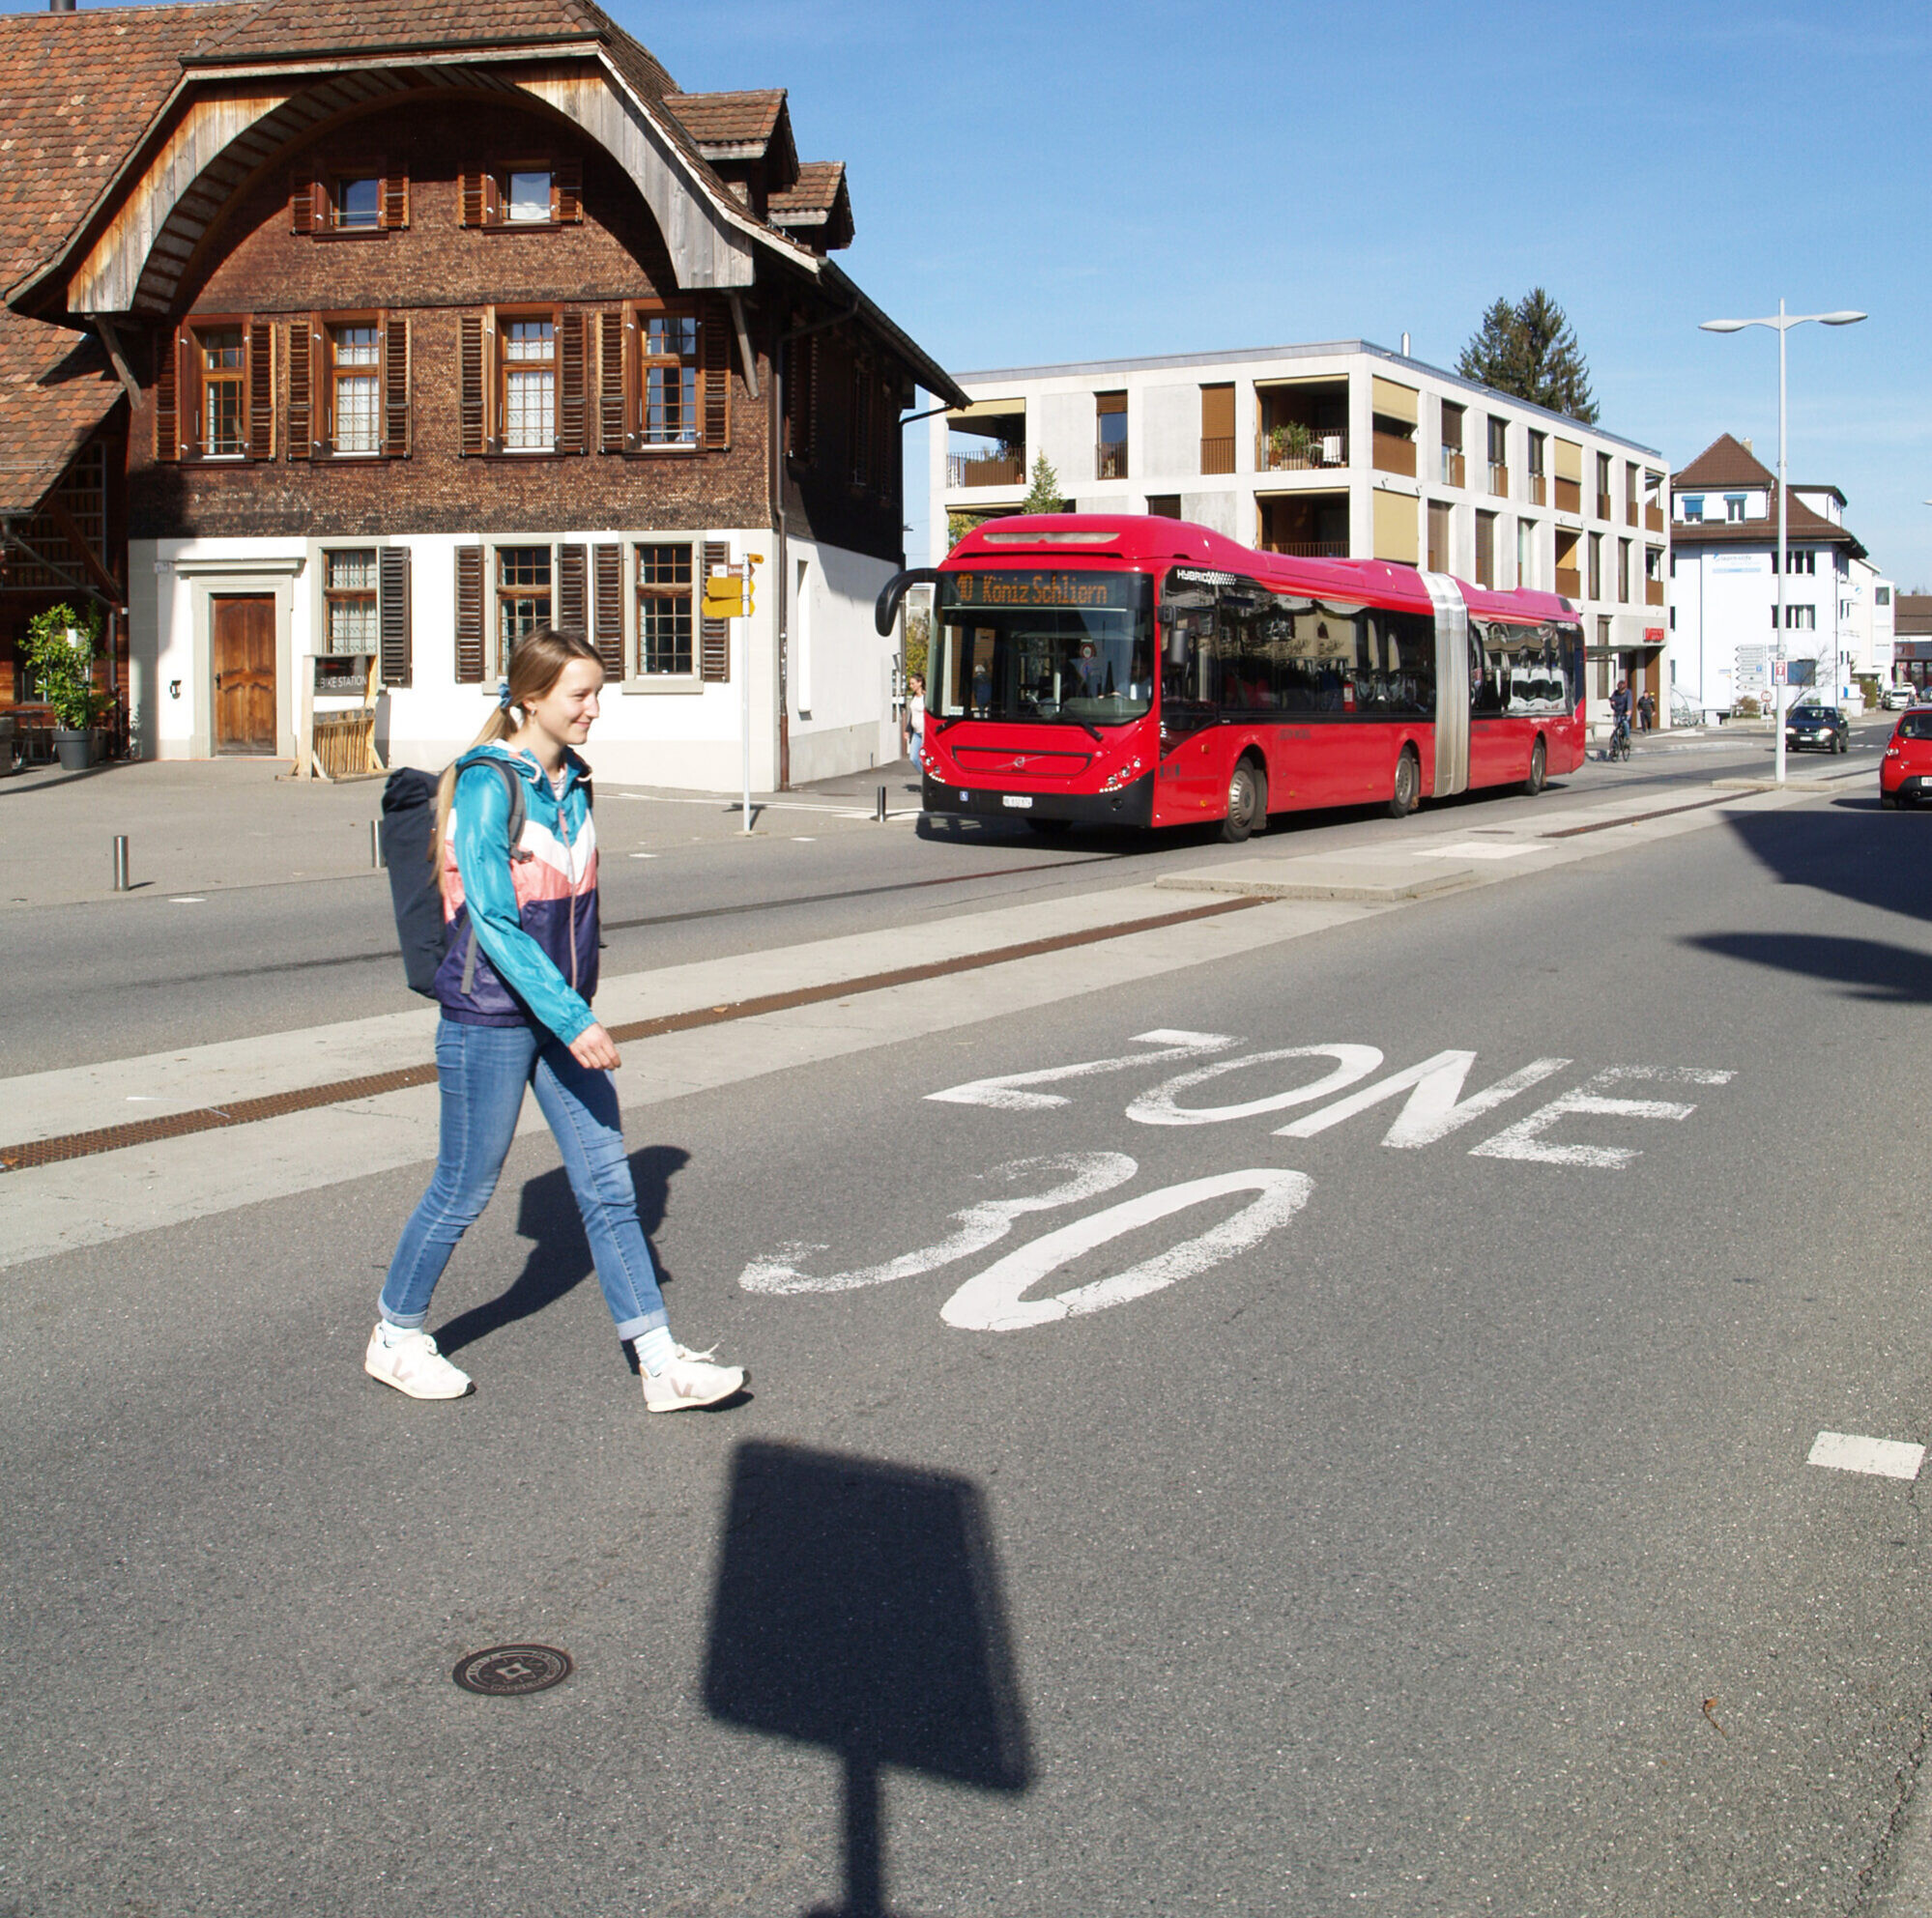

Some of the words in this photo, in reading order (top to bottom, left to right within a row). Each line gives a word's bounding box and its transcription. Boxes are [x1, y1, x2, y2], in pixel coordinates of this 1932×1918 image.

[982, 574, 1029, 603] Köniz
[1031, 574, 1108, 604] Schliern
[337, 674, 367, 688] STATION
[923, 1028, 1737, 1168] ZONE
[737, 1151, 1313, 1332] 30
